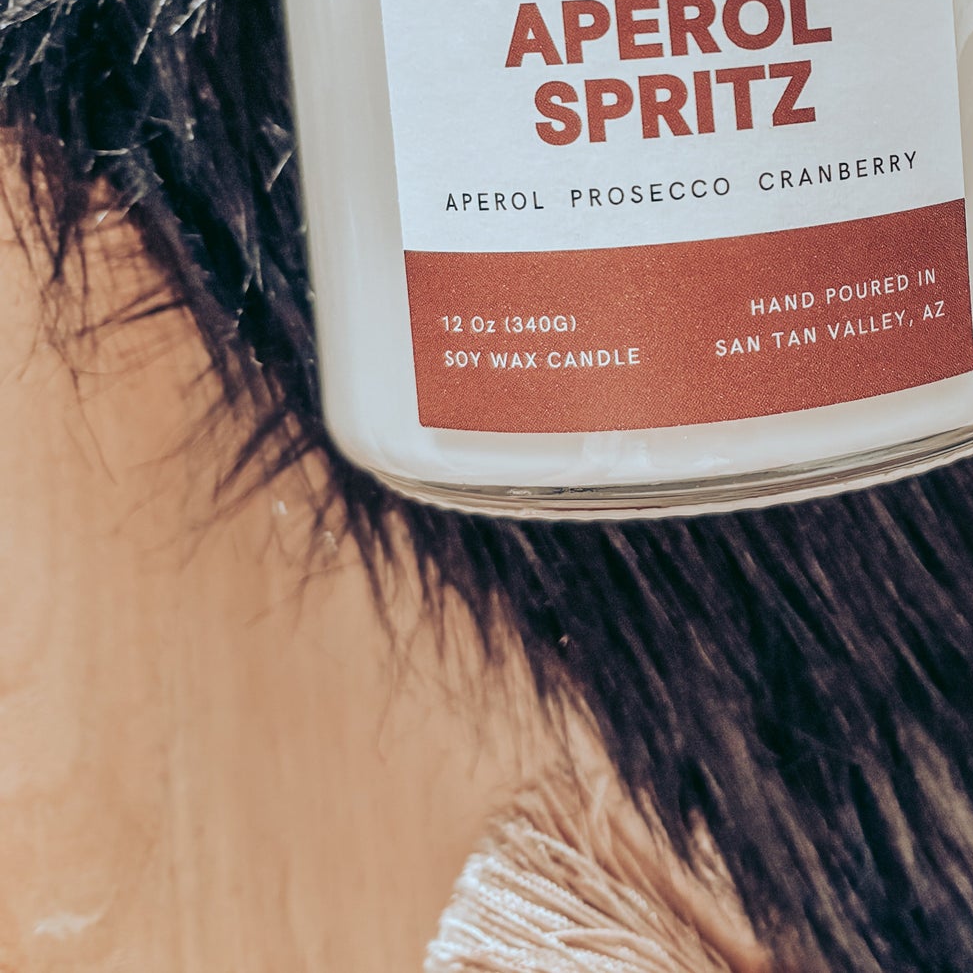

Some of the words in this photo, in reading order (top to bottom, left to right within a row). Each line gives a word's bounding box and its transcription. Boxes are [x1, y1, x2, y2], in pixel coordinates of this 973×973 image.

[533, 60, 817, 146] SPRITZ
[445, 189, 545, 212] APEROL
[570, 176, 732, 208] PROSECCO
[758, 151, 919, 192] CRANBERRY
[750, 291, 816, 317] HAND
[826, 273, 911, 305] POURED
[917, 268, 937, 287] IN
[442, 315, 463, 333] 12
[503, 313, 578, 334] (340G)
[715, 335, 761, 358] SAN
[771, 326, 818, 350] TAN
[826, 310, 915, 342] VALLEY,
[922, 300, 946, 322] AZ
[444, 350, 482, 368] SOY
[490, 350, 538, 369] WAX
[547, 347, 641, 368] CANDLE
